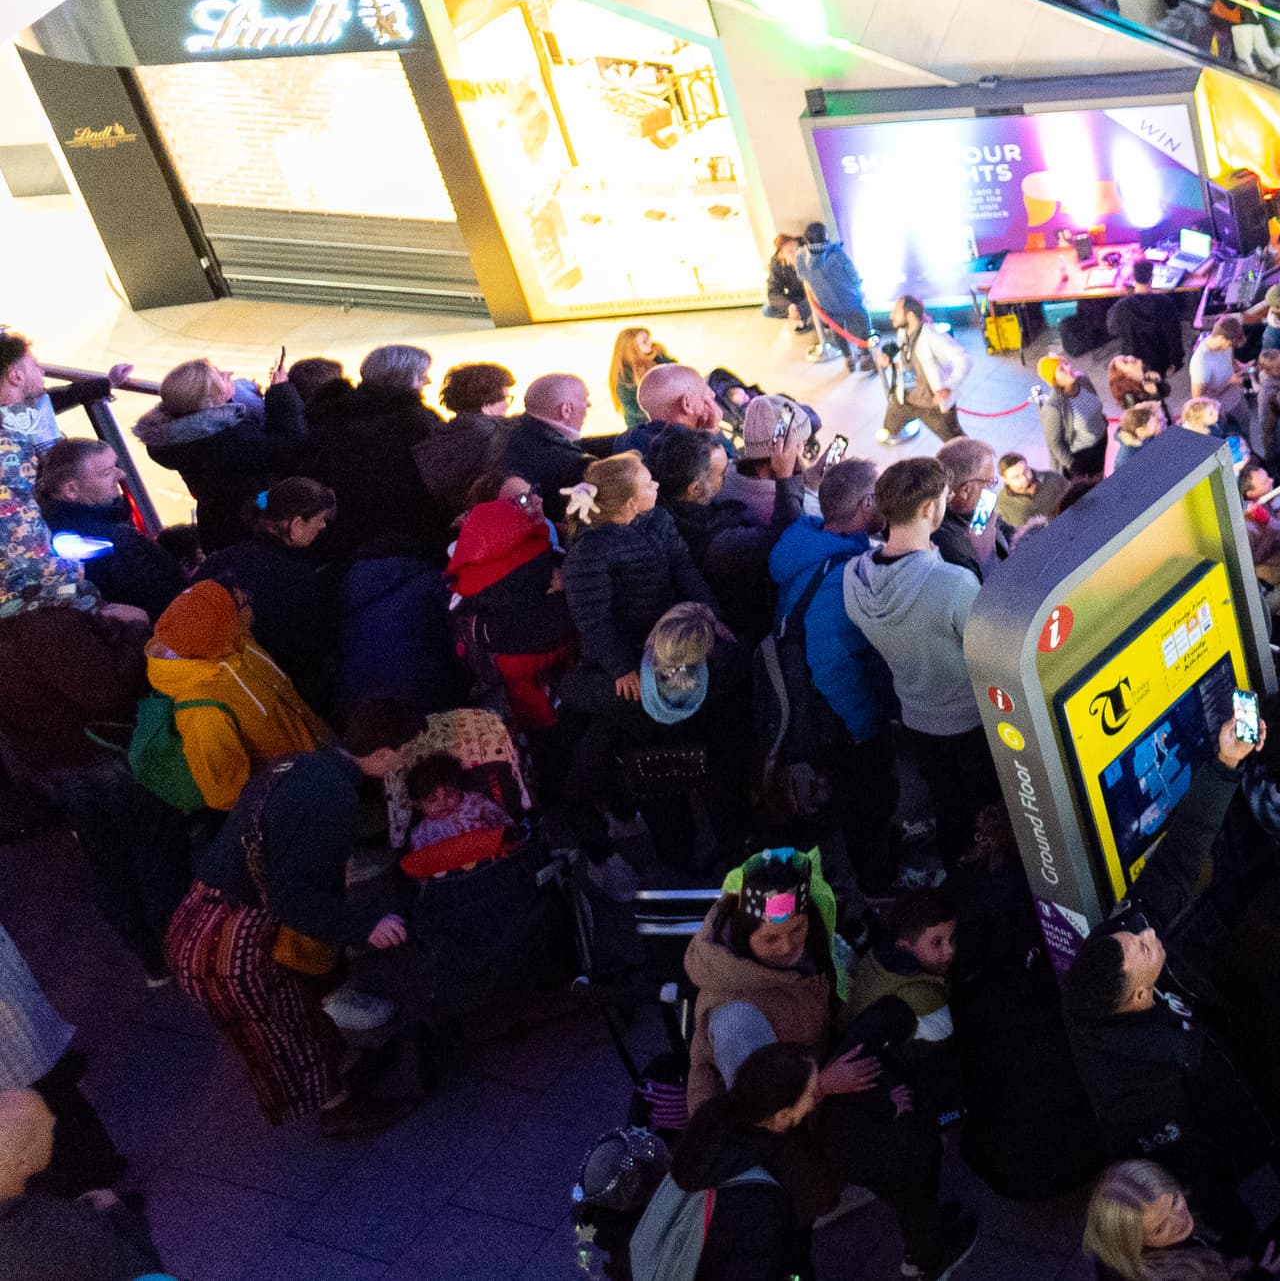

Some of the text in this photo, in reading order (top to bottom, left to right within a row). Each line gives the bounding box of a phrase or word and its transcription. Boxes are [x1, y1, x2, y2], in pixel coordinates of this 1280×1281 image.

[1140, 118, 1181, 153] WIN
[960, 144, 1022, 164] OUR
[1013, 759, 1059, 885] Ground Floor
[1046, 938, 1077, 957] THOUG
